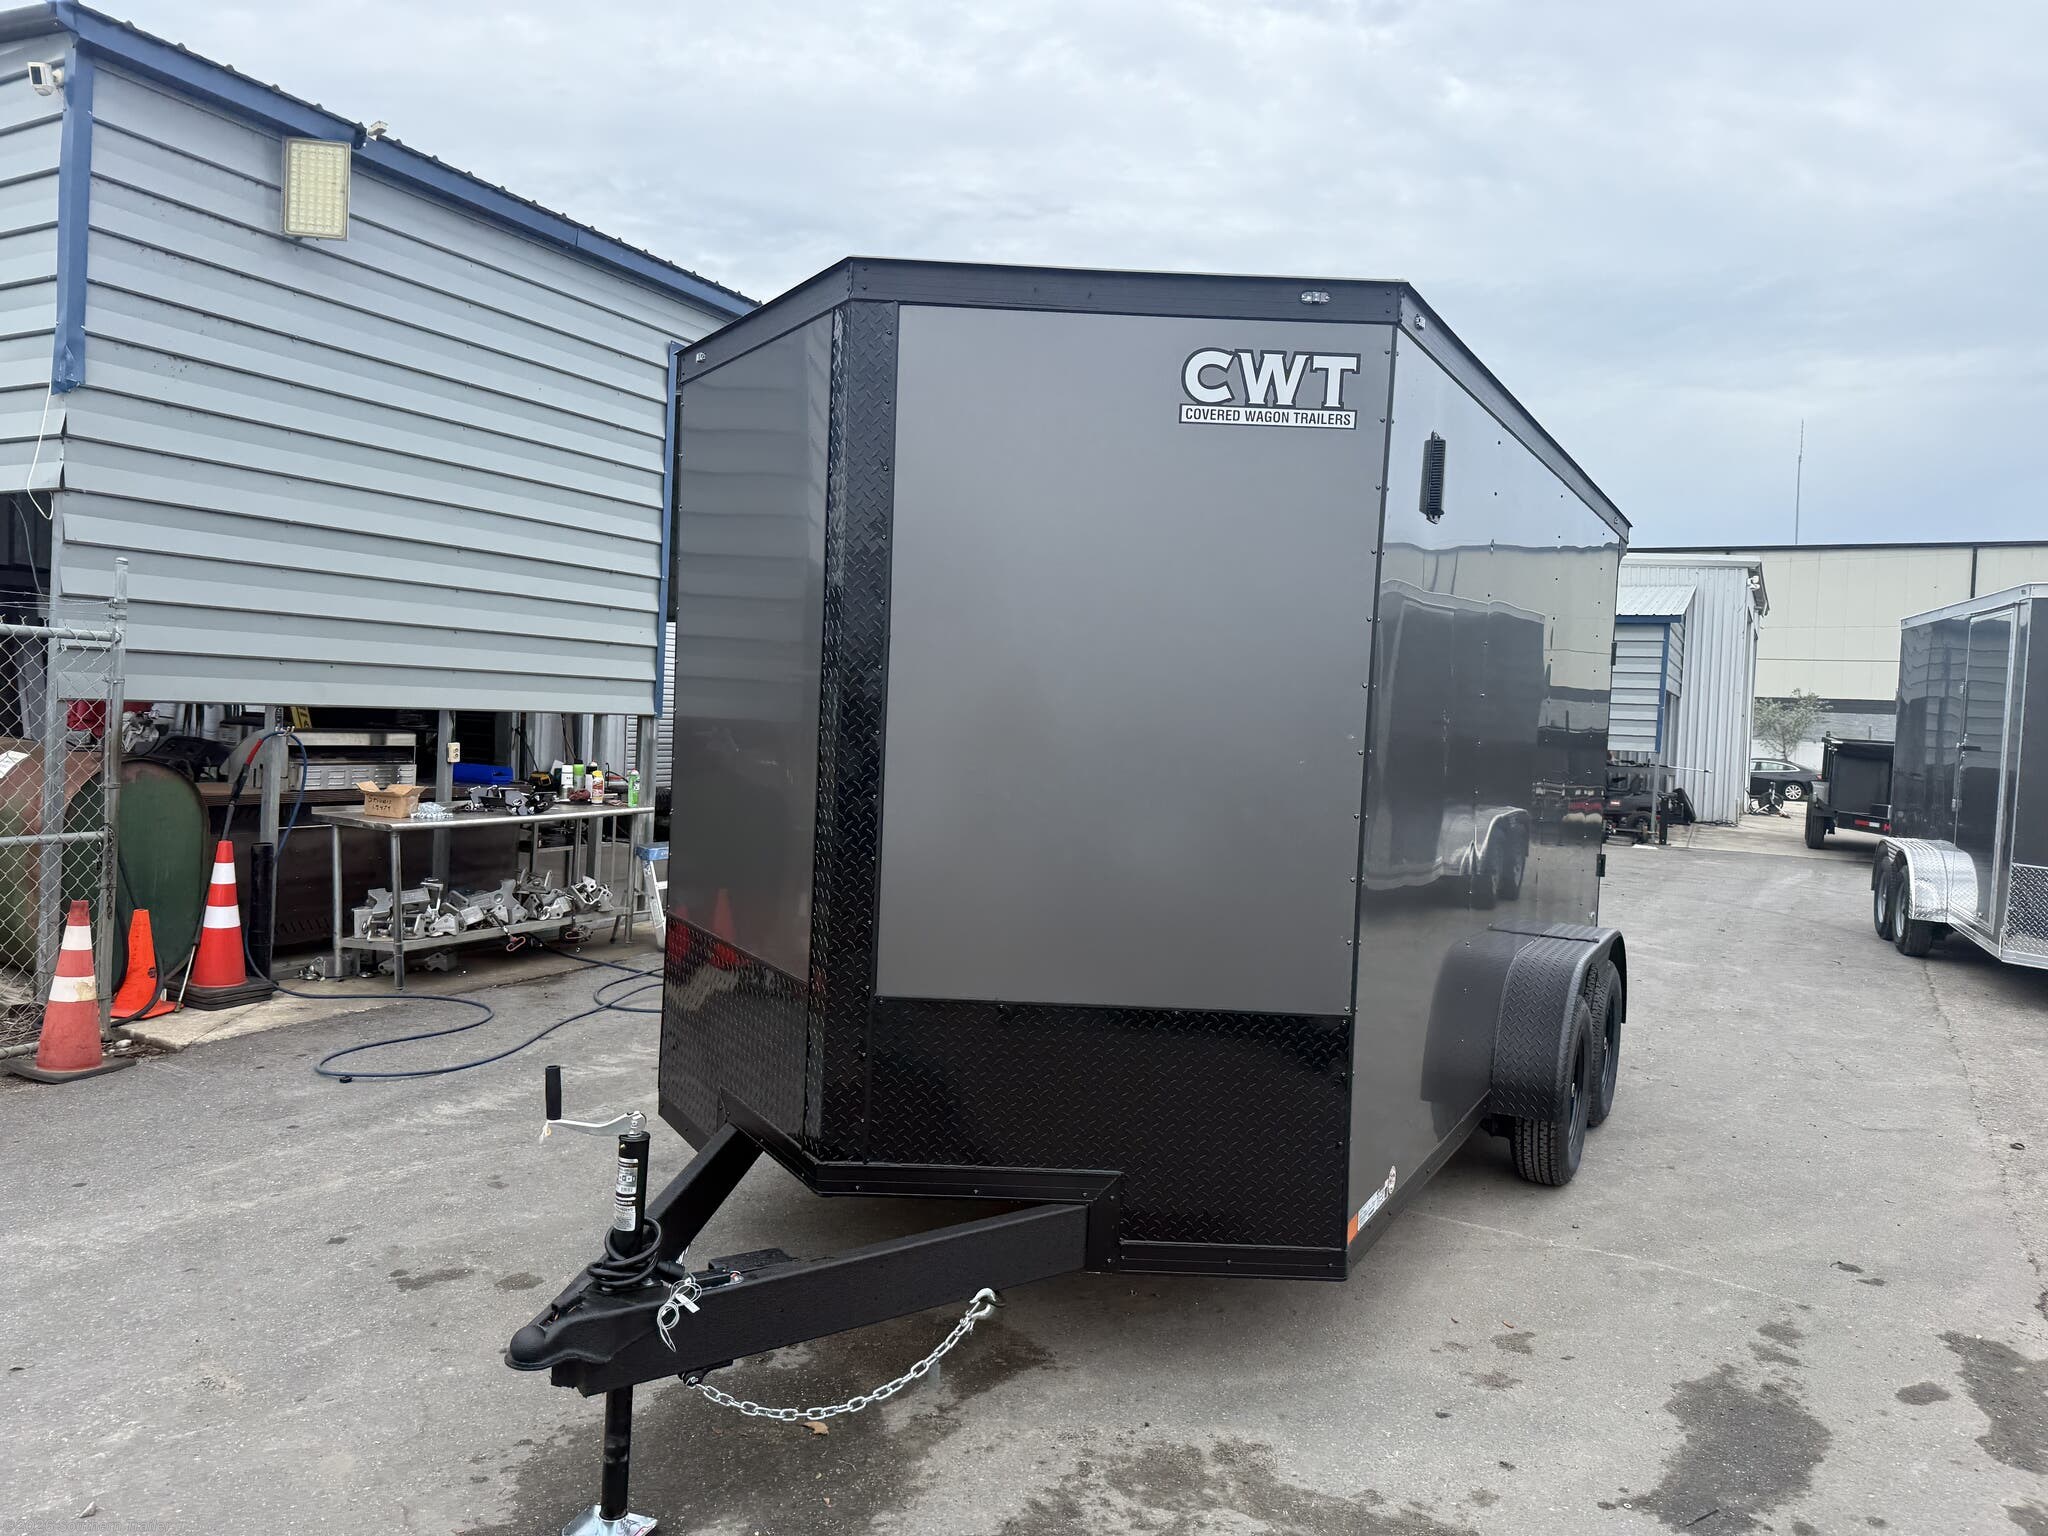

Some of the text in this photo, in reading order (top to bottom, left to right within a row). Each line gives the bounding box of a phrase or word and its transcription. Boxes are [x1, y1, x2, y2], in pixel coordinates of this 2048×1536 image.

[1182, 348, 1360, 409] CWT
[1185, 407, 1352, 426] COVERED WAGON TRAILERS
